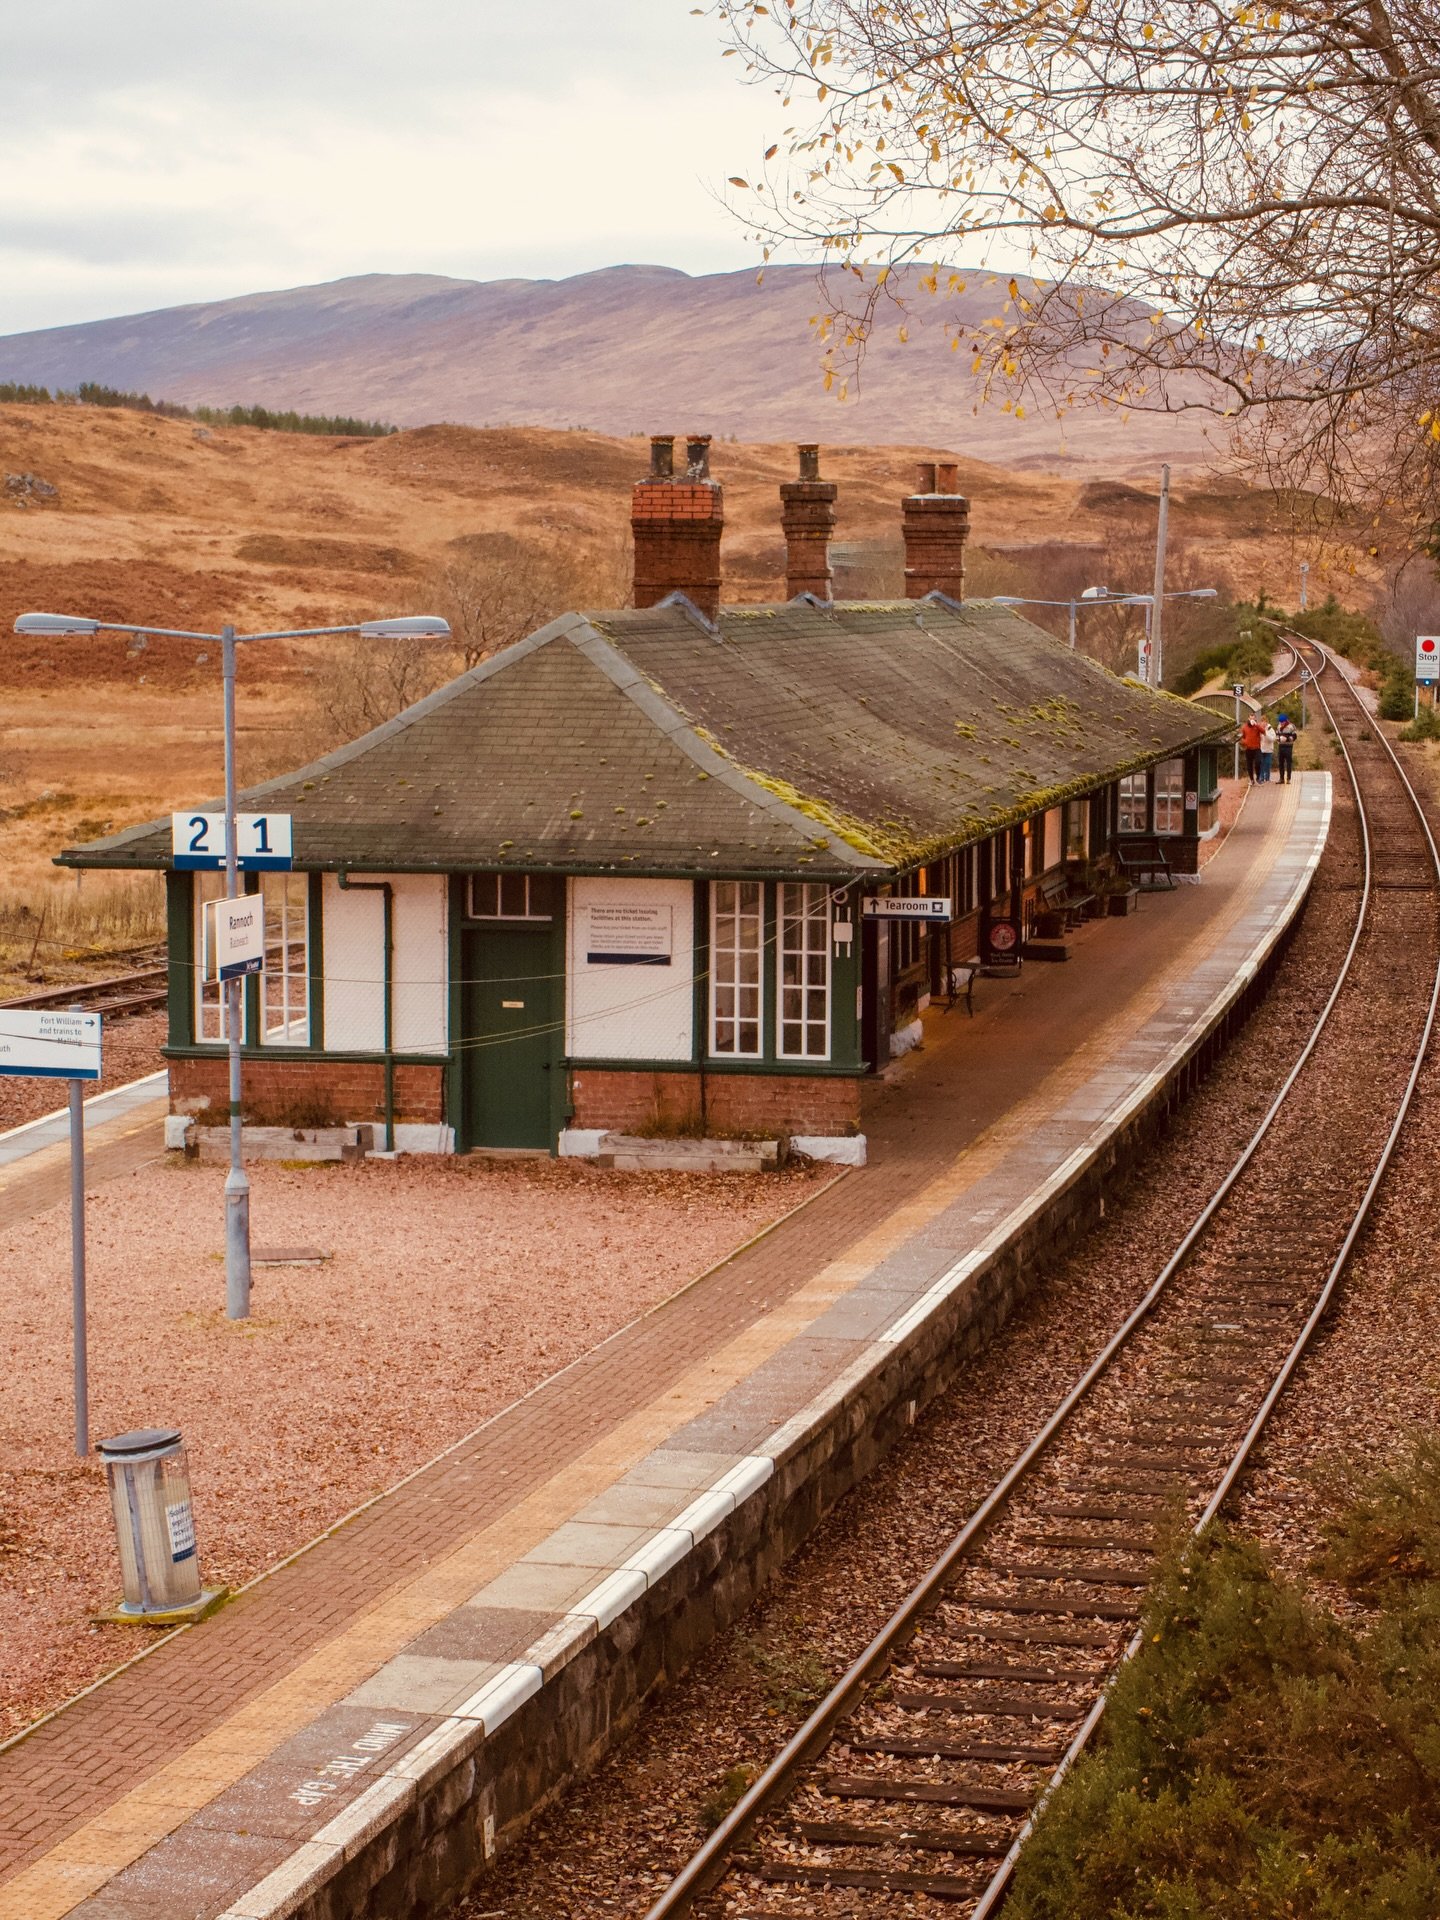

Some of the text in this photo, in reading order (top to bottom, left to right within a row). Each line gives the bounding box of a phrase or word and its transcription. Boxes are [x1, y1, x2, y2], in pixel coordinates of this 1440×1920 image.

[1418, 653, 1438, 662] Stop
[188, 816, 209, 852] 2
[252, 817, 273, 853] 1
[885, 900, 928, 911] Tearoom
[229, 912, 254, 930] Rannoch
[41, 1016, 82, 1025] Fort William
[352, 1722, 411, 1751] MIND
